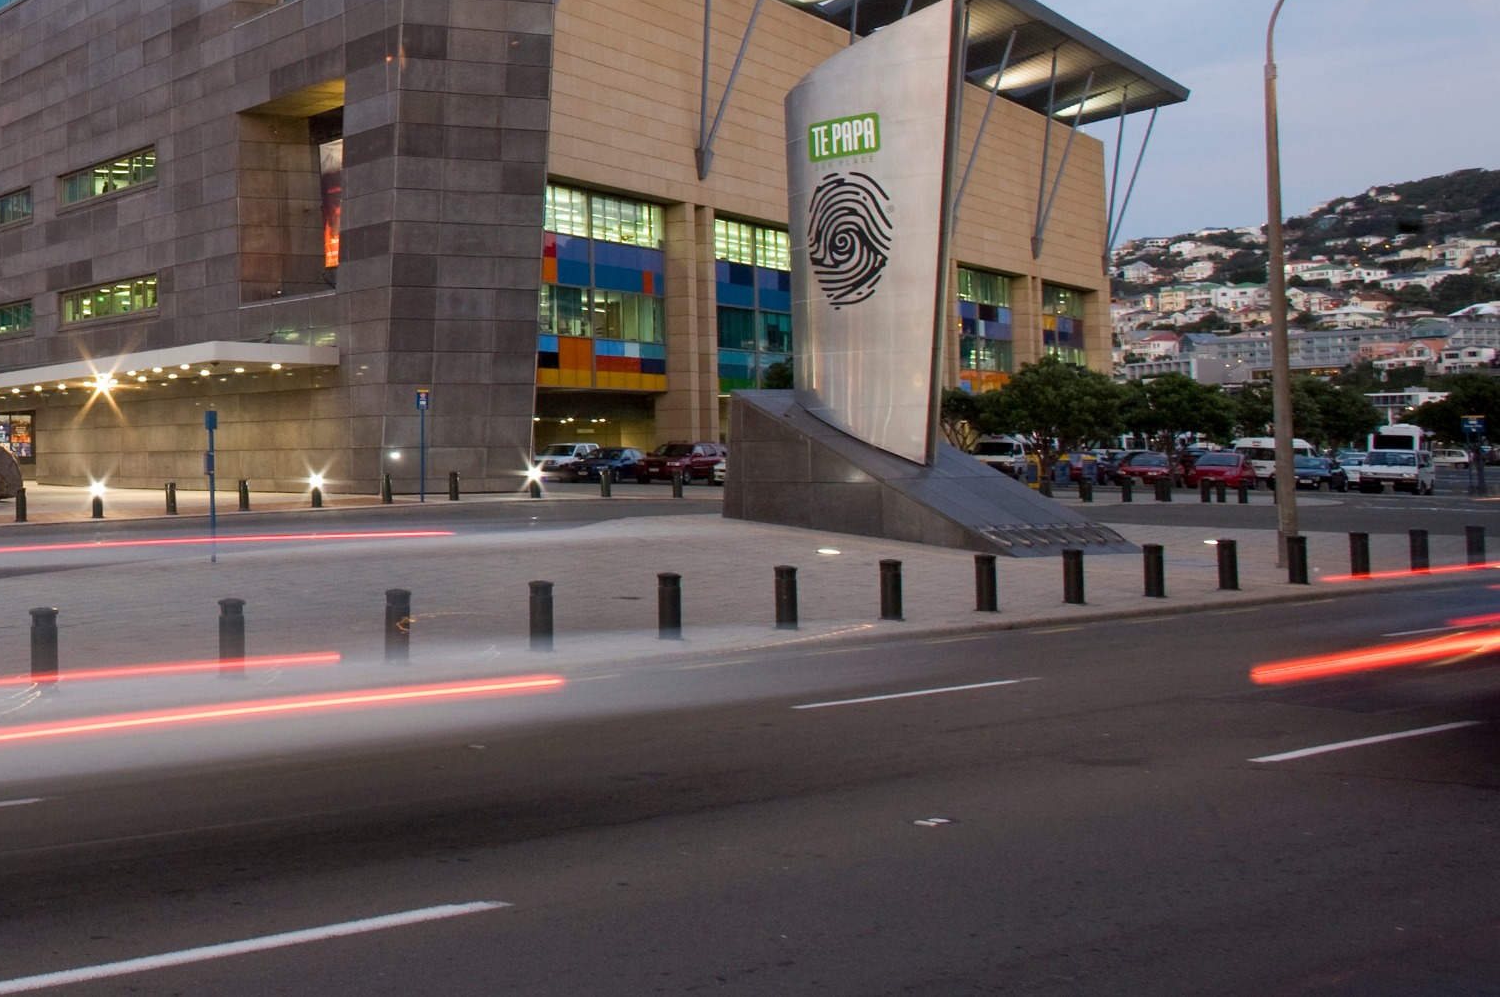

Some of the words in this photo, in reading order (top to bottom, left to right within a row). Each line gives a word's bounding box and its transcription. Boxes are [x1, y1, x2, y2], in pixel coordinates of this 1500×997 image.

[811, 125, 829, 157] TE
[832, 117, 876, 154] PAPA
[839, 155, 874, 166] PLACE
